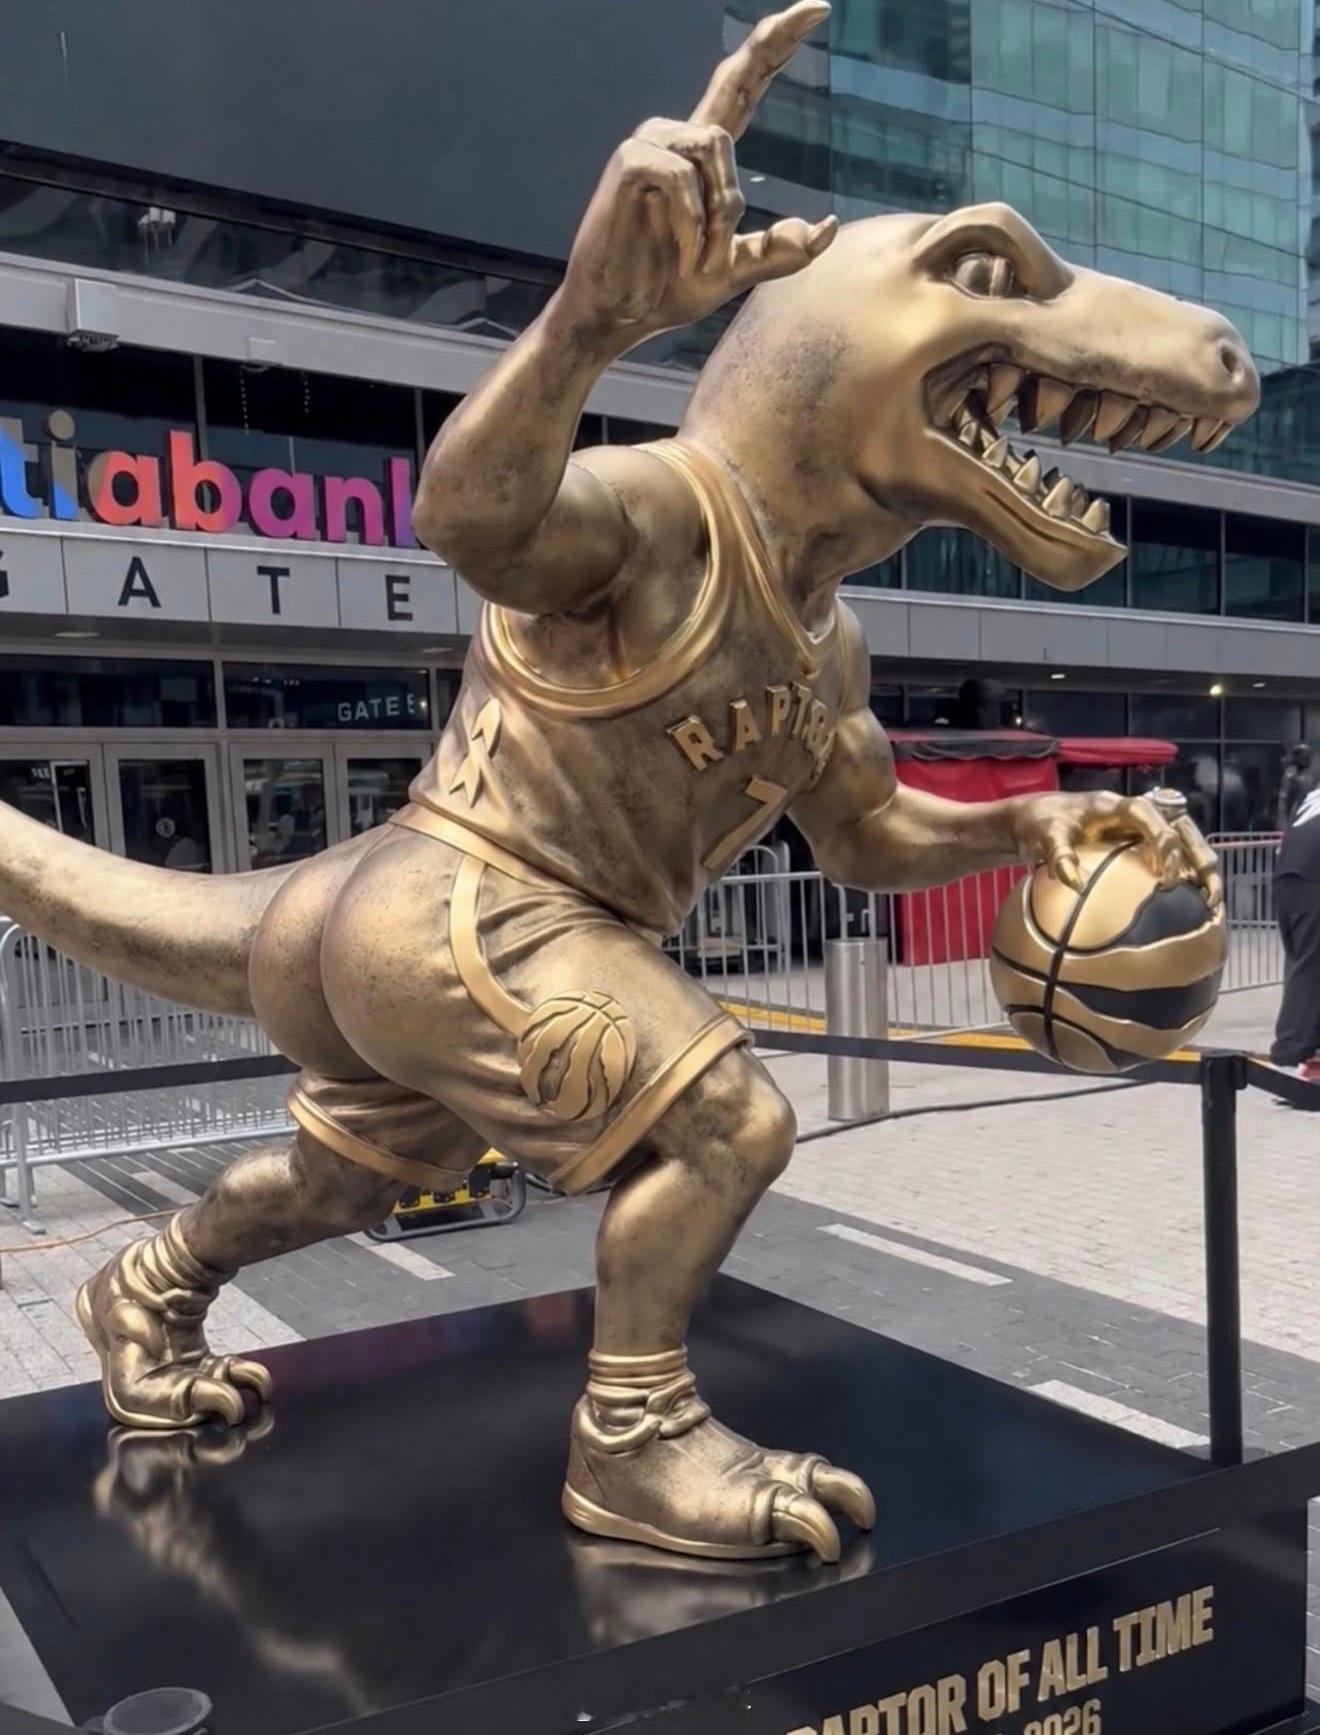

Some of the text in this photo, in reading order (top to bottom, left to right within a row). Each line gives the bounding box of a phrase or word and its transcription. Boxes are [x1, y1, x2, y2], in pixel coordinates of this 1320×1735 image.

[0, 551, 413, 621] ATE
[337, 696, 400, 721] GATE
[703, 774, 789, 870] 7
[786, 1585, 1215, 1735] PTOR OF ALL TIME
